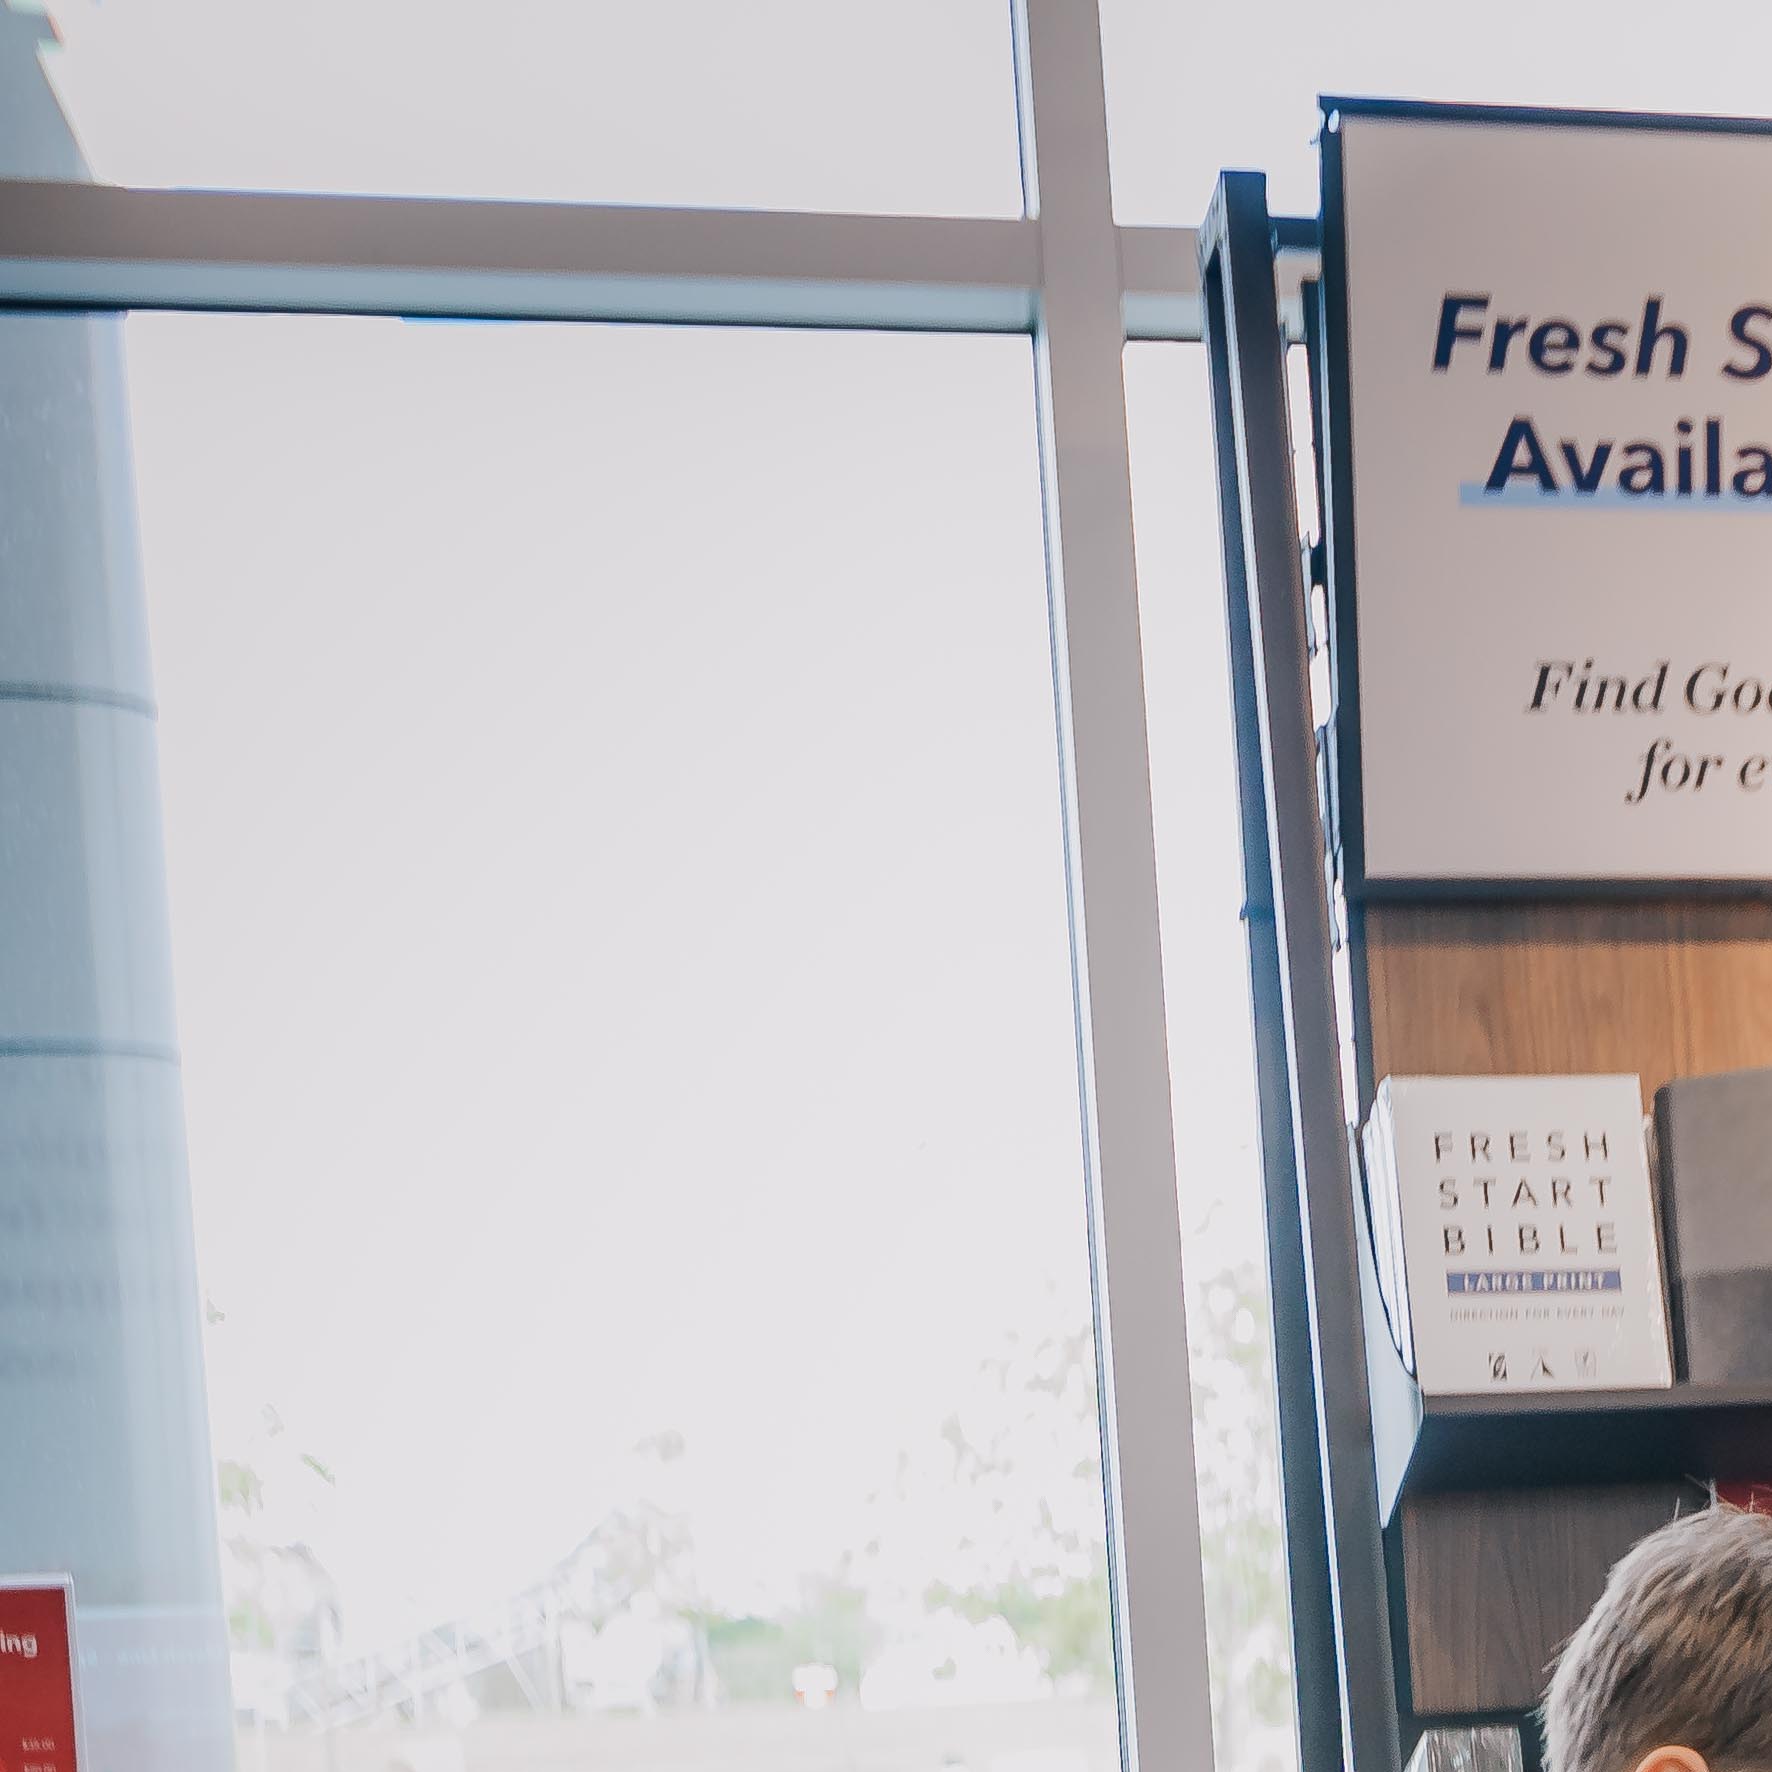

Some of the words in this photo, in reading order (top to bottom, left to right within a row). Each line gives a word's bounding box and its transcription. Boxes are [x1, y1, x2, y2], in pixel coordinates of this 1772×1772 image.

[1431, 292, 1690, 380] Fresh
[1525, 661, 1666, 718] Find
[1627, 738, 1723, 806] for
[1434, 1130, 1610, 1164] FRESH
[1439, 1176, 1612, 1210] START
[1443, 1222, 1618, 1256] BIBLE
[0, 1630, 38, 1659] ing
